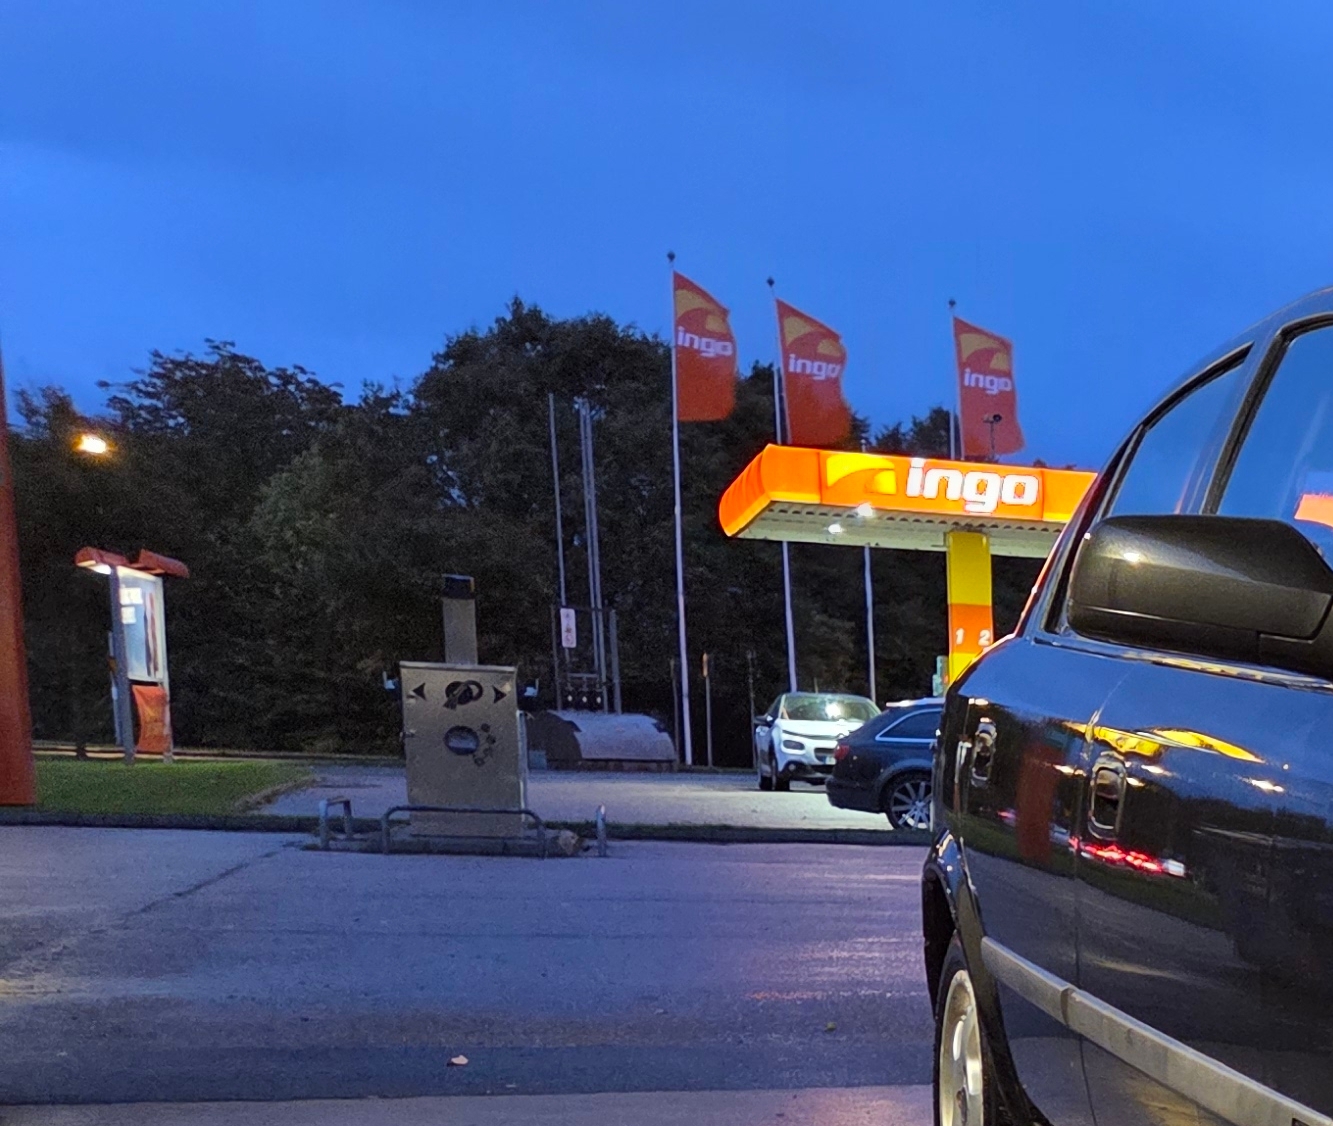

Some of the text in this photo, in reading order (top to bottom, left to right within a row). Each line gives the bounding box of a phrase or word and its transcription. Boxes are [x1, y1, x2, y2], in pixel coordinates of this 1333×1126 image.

[677, 326, 733, 357] ingo
[789, 354, 841, 381] ingo
[964, 367, 1013, 395] ingo
[905, 457, 1040, 514] ingo
[955, 628, 991, 646] 1 2
